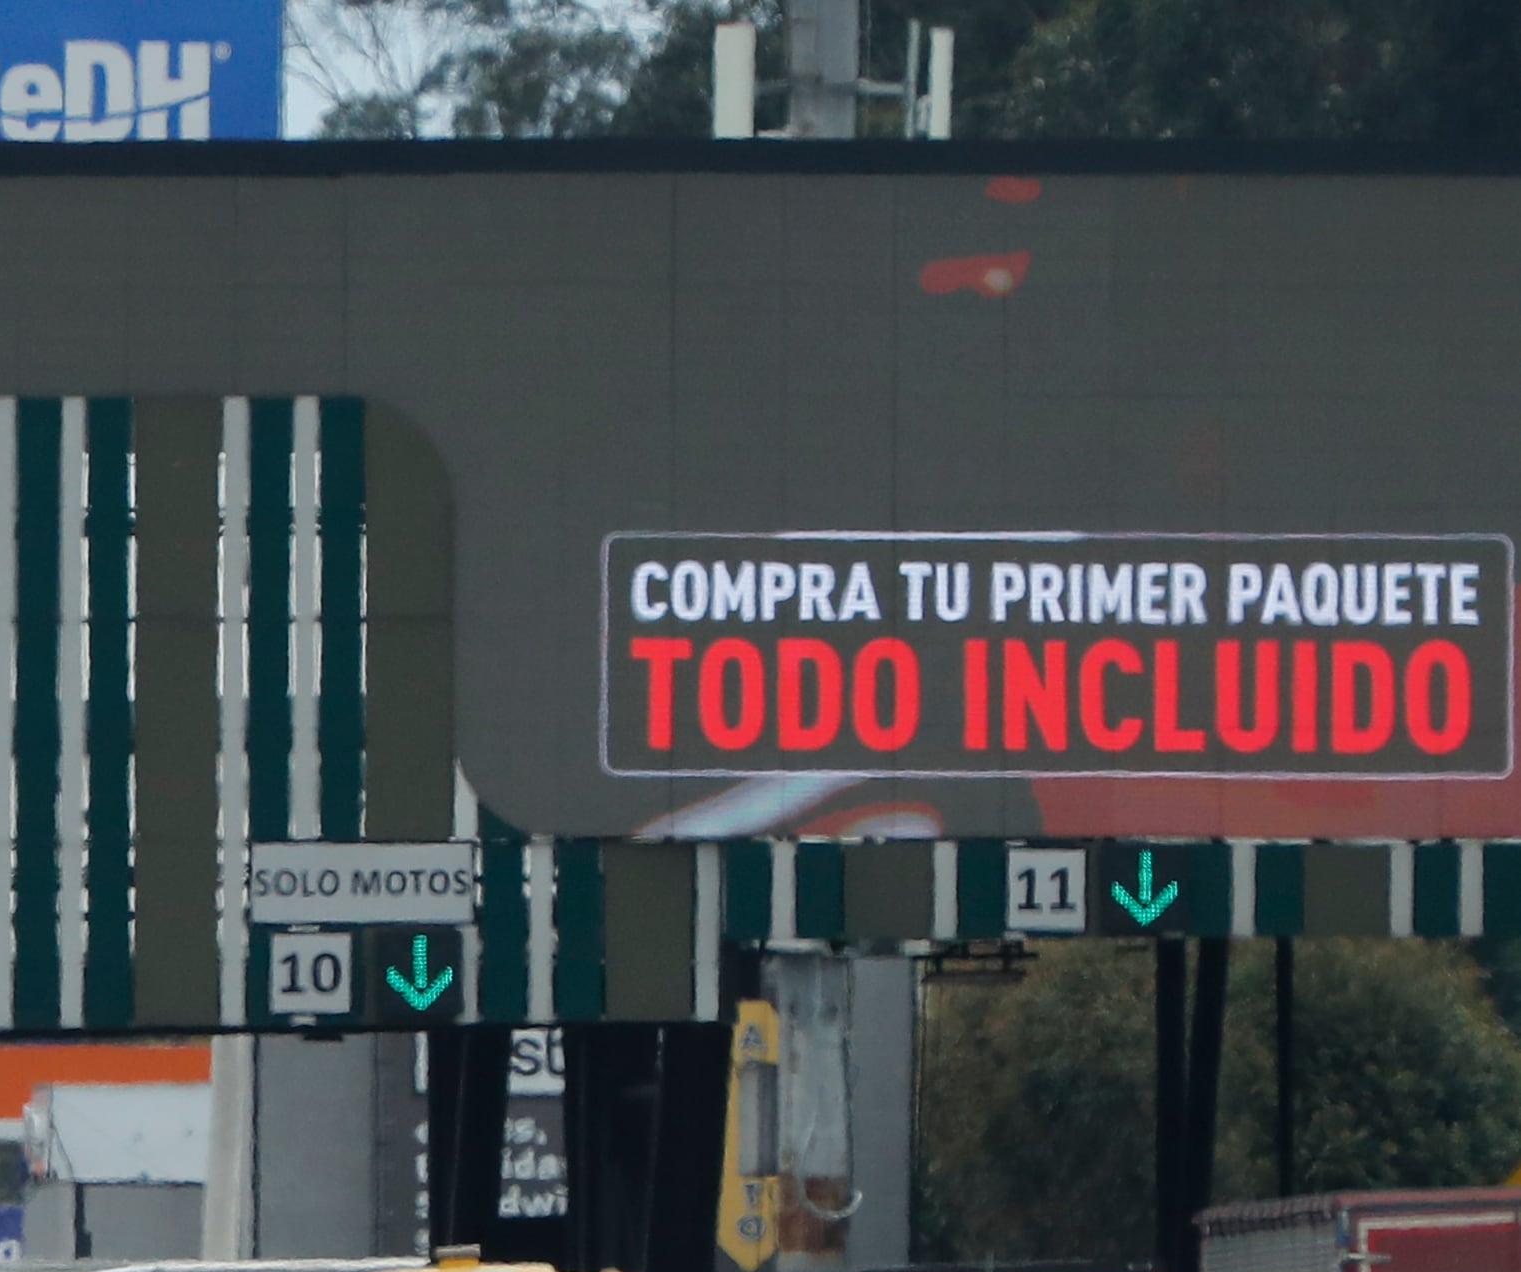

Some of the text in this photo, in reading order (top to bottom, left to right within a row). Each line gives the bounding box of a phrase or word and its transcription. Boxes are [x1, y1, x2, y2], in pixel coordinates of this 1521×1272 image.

[630, 560, 1481, 627] COMPRA TU PRIMER PAQUETE
[629, 636, 1472, 755] TODO INCLUIDO
[254, 868, 470, 898] SOLO MOTOS
[1016, 867, 1078, 913] 11
[279, 953, 342, 994] 10
